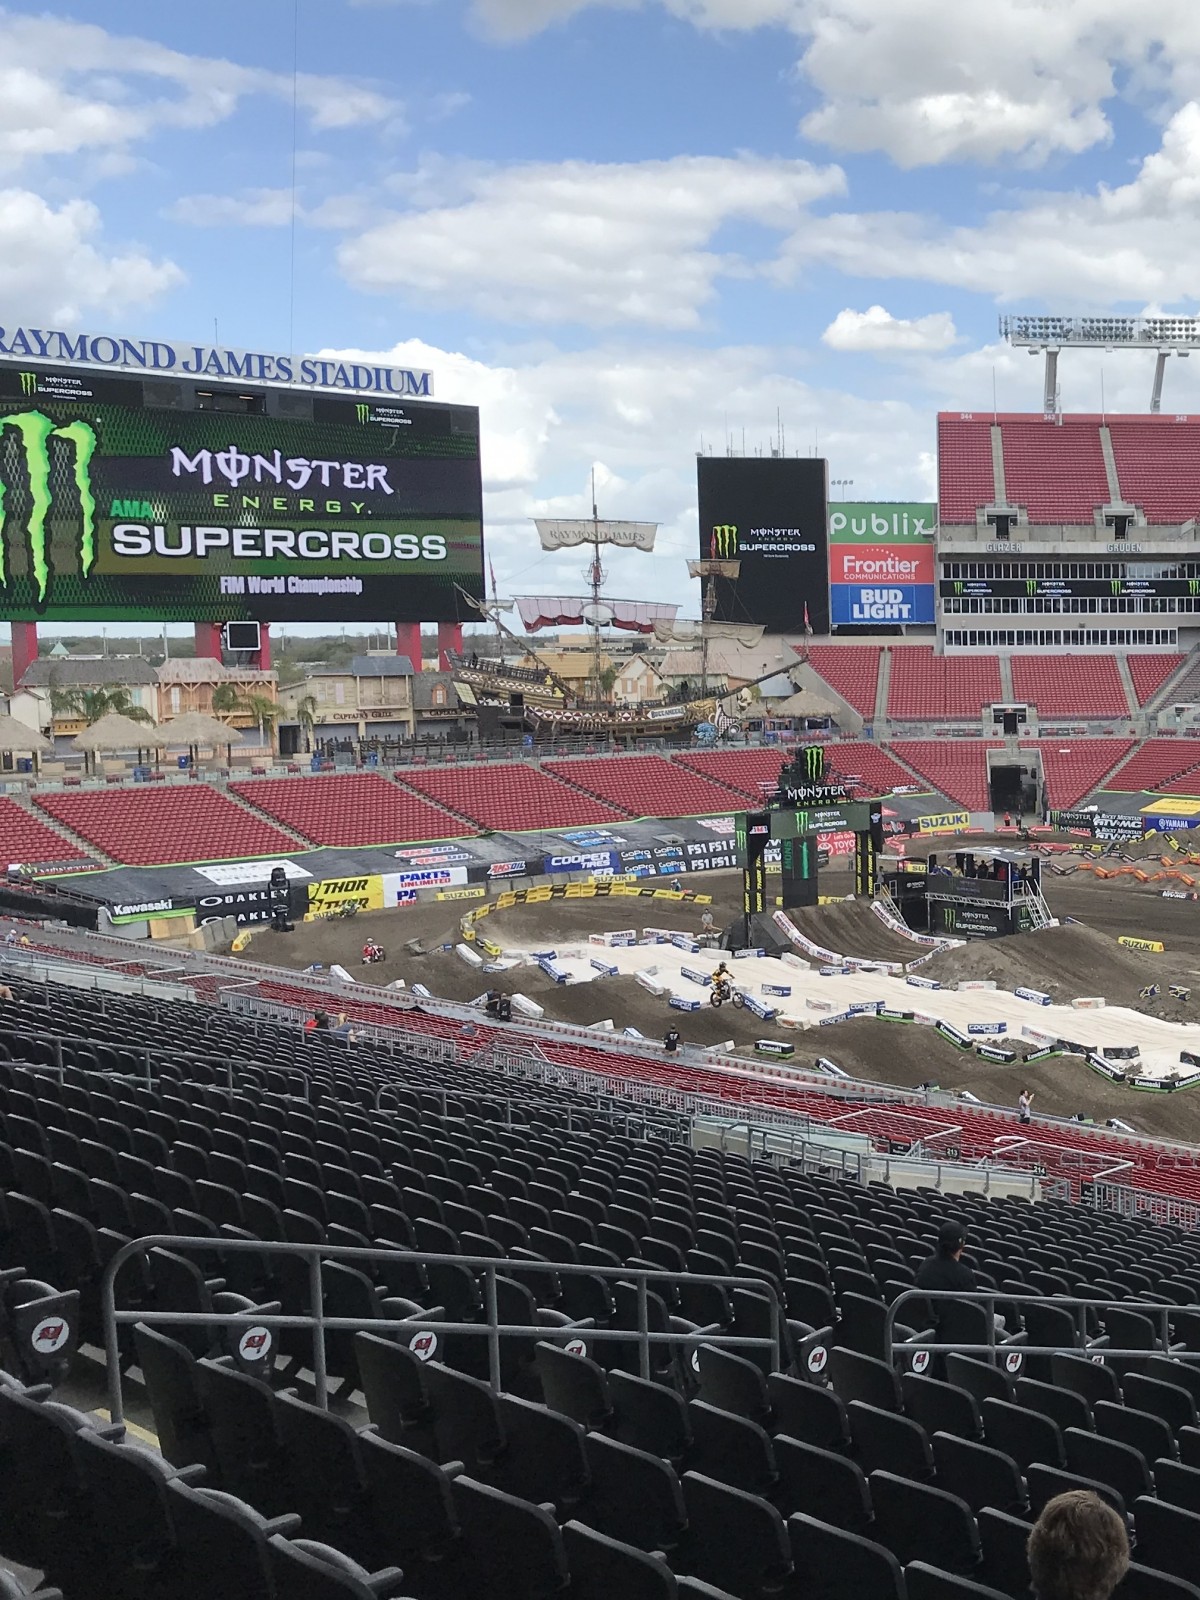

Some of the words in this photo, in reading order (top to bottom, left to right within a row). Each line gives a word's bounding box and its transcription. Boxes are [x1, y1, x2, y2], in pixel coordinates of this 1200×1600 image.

[183, 346, 293, 383] JAMES
[301, 359, 433, 397] STADIUM
[170, 445, 394, 494] MONSTER
[110, 500, 153, 519] AMA
[829, 512, 926, 535] Publix
[750, 528, 801, 537] MONSTER
[112, 524, 447, 560] SUPERCROSS
[986, 543, 1022, 552] GLAZER
[1106, 543, 1142, 552] GRUDEN
[843, 555, 920, 573] Frontier
[220, 576, 246, 594] FIM
[248, 576, 286, 594] World
[287, 576, 363, 596] Championship
[860, 588, 904, 604] BUD
[852, 603, 912, 619] LIGHT
[787, 785, 846, 800] MONSTER
[921, 815, 969, 828] SUZUKI
[1165, 819, 1189, 829] YAMAHA
[620, 849, 651, 858] GoPro
[654, 846, 683, 854] GoPro
[687, 844, 708, 856] FS1
[709, 840, 728, 853] FS1
[551, 851, 611, 866] COOPER
[580, 860, 611, 869] TIRES
[658, 860, 686, 868] GoPro
[691, 859, 710, 871] FS1
[711, 856, 729, 869] FS1
[488, 861, 526, 876] AMSOIL
[624, 862, 655, 873] GoPro
[400, 870, 451, 882] PARTS
[593, 875, 632, 883] SUZUKI
[323, 879, 369, 894] THOR
[400, 878, 451, 888] UNLIMITED
[224, 889, 289, 903] OAKLEY
[443, 890, 481, 900] SUZUKI
[114, 899, 173, 915] Kawasaki
[956, 923, 998, 932] SUPERCROSS
[1122, 938, 1154, 950] SUZUKI
[669, 998, 692, 1008] COOPER
[850, 1003, 878, 1011] COOPER
[968, 1023, 999, 1032] COOPER
[759, 1043, 782, 1053] Kawasaki
[981, 1050, 1005, 1062] Kawasaki
[1134, 1078, 1161, 1088] Kawasaki
[1174, 1073, 1200, 1088] Kawasaki
